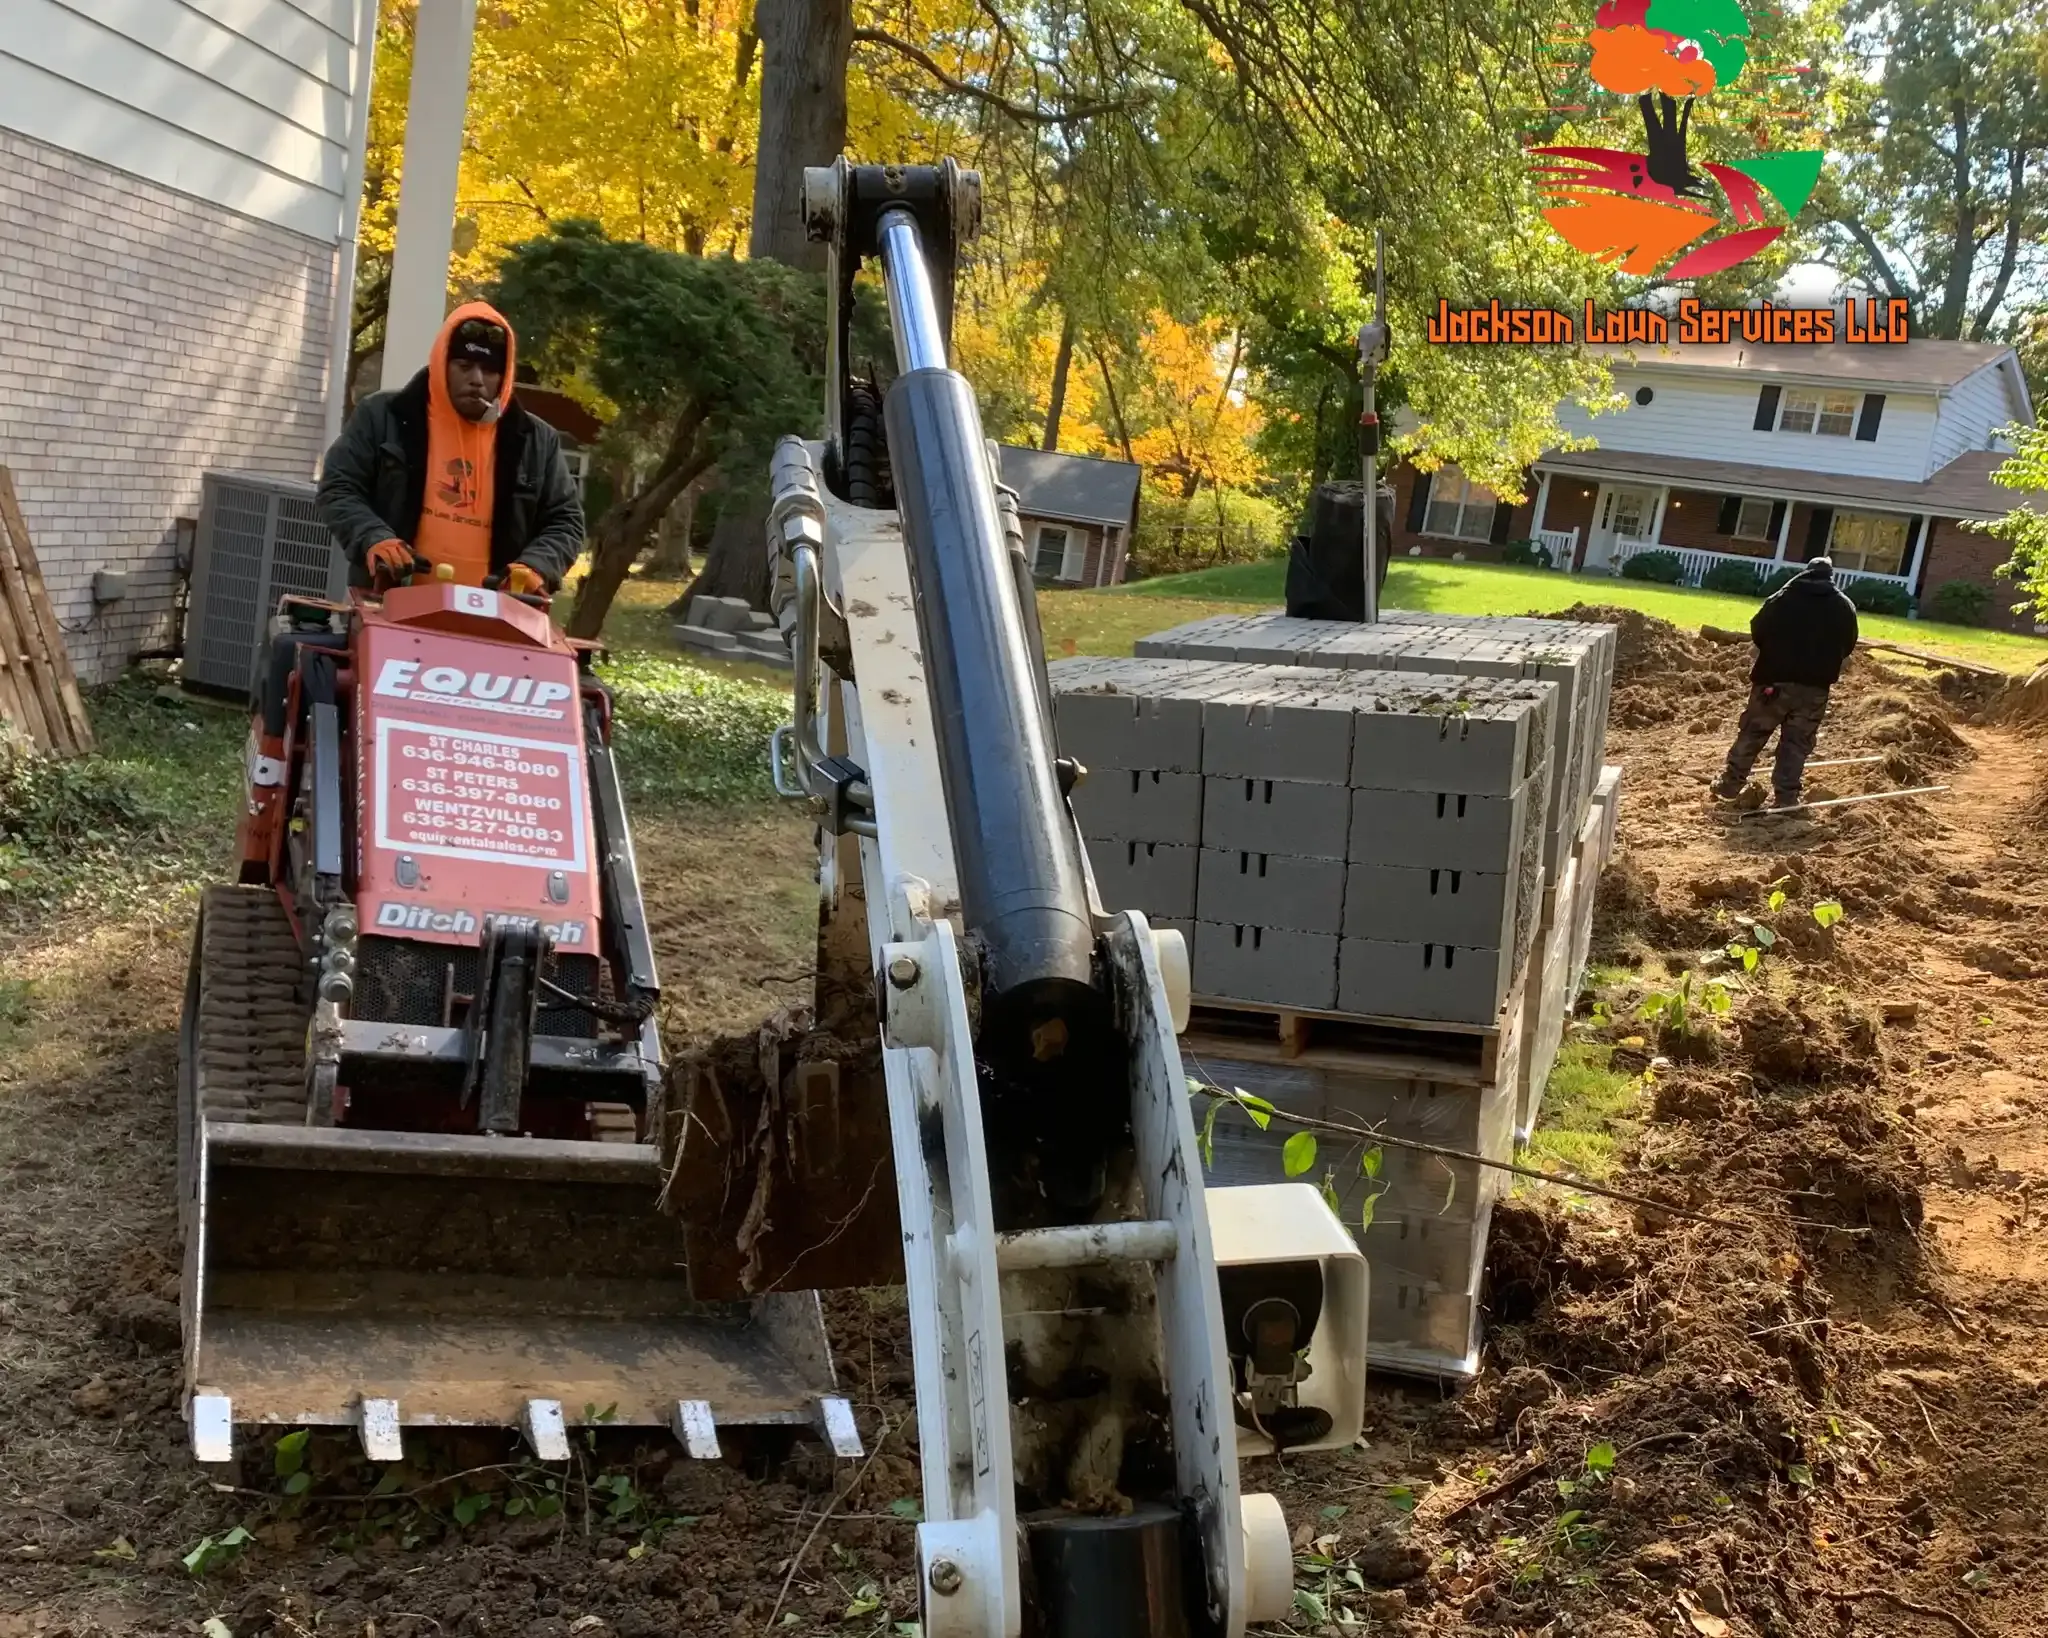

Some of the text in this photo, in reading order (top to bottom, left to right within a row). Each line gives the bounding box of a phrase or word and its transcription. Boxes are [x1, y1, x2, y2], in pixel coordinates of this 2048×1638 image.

[373, 659, 571, 706] EQUIP
[402, 744, 560, 778] 636-946-8080
[429, 735, 520, 760] ST CHARLES
[426, 766, 519, 790] ST PETERS
[402, 778, 562, 810] 636-397-8080
[414, 798, 538, 826] WENTZVILLE
[377, 902, 475, 933] Ditch
